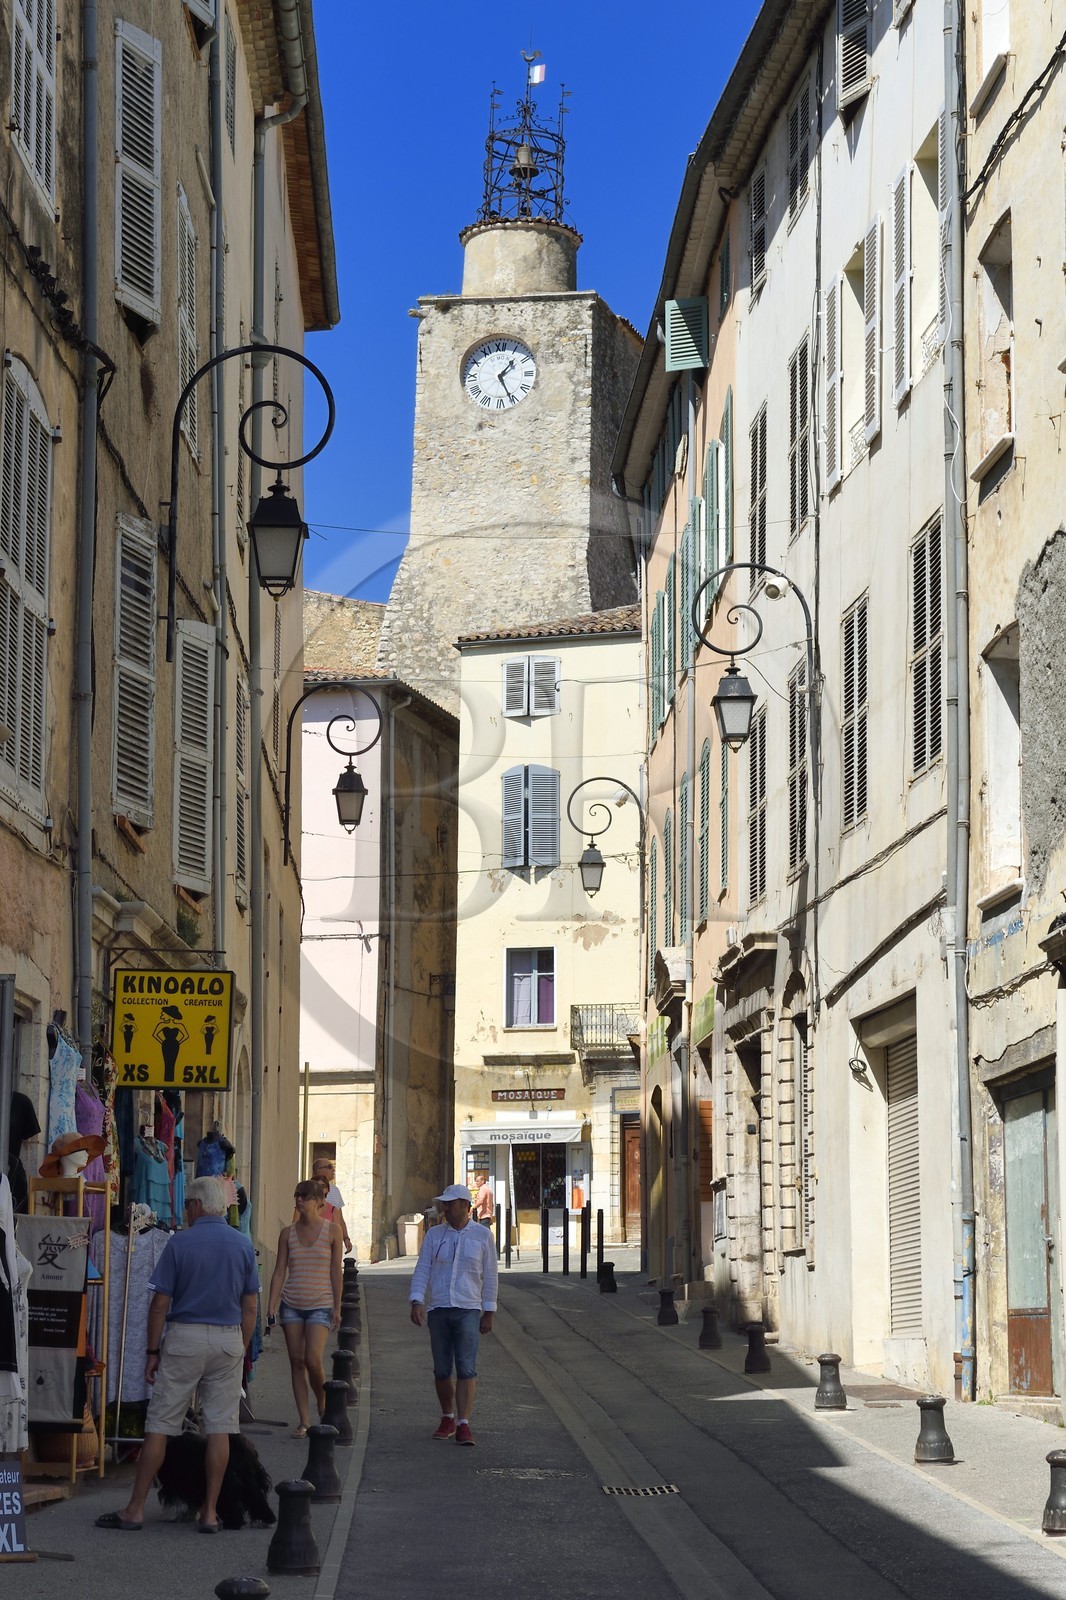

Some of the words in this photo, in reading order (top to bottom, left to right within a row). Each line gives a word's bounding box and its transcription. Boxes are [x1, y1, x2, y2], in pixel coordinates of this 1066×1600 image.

[495, 342, 507, 352] XII
[123, 975, 224, 995] KINOALO
[122, 997, 169, 1005] COLLECTION
[184, 999, 223, 1007] CREATEUR
[122, 1063, 150, 1082] XS
[182, 1065, 220, 1084] 5XL
[497, 1090, 557, 1101] MOSAIQUE
[490, 1131, 552, 1142] mosaïque
[36, 1233, 67, 1270] 愛
[40, 1273, 64, 1281] Amour
